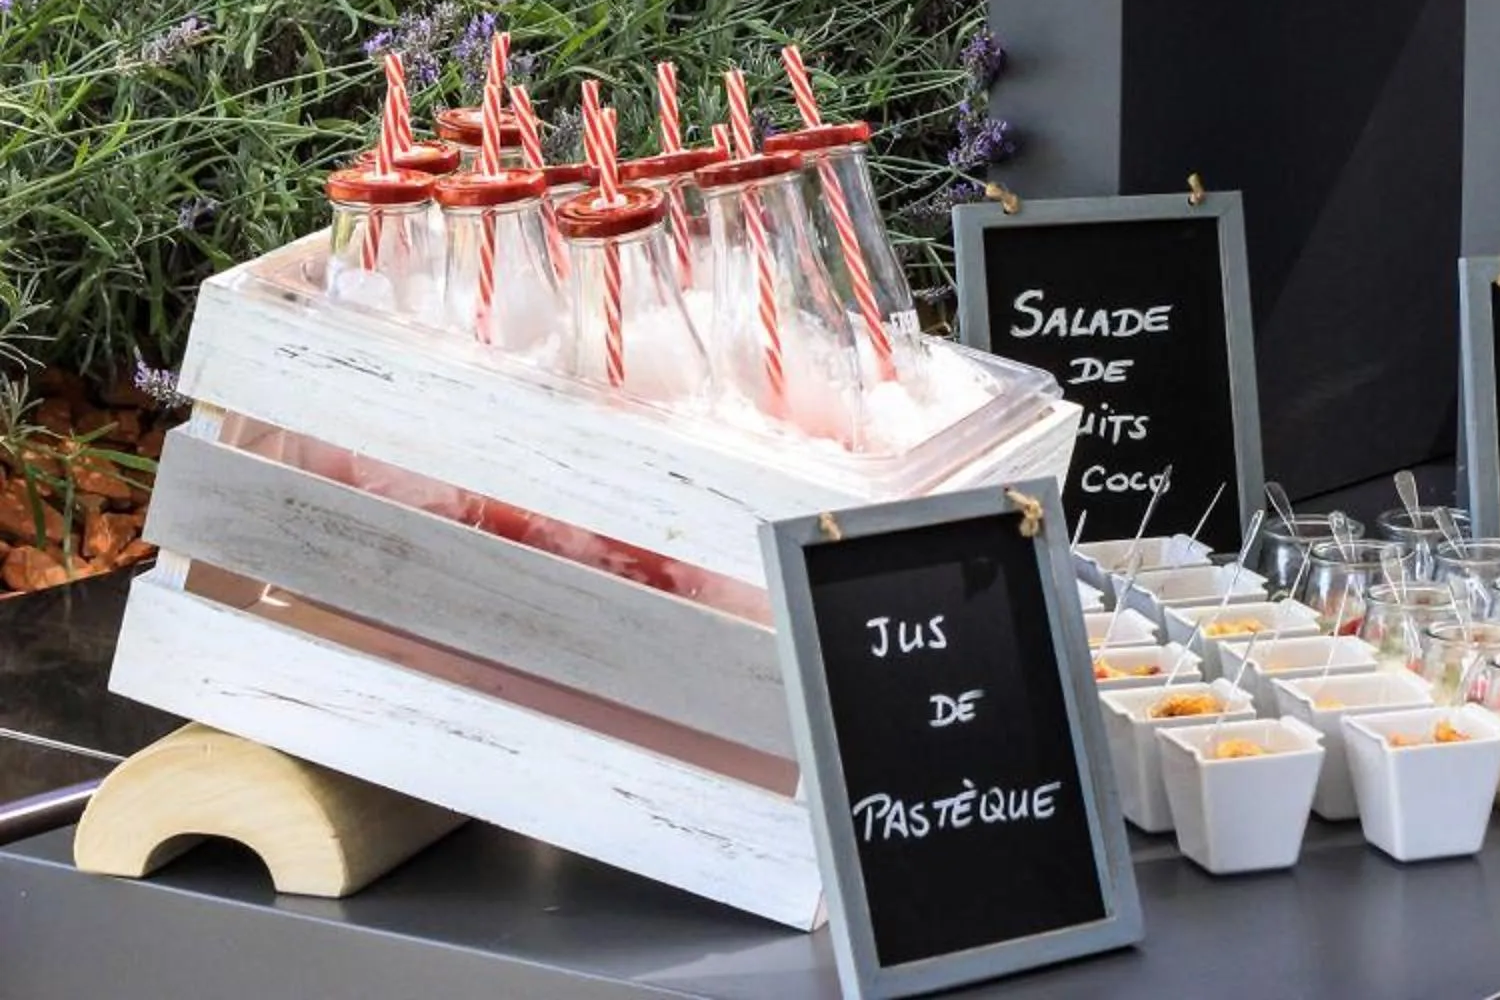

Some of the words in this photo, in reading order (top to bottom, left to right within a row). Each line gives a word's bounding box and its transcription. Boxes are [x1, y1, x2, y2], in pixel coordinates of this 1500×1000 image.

[1010, 290, 1173, 338] SALADE
[1067, 357, 1135, 386] DE
[866, 615, 948, 658] JUS
[929, 690, 985, 727] DE
[852, 778, 1062, 842] PASTÈQUE
